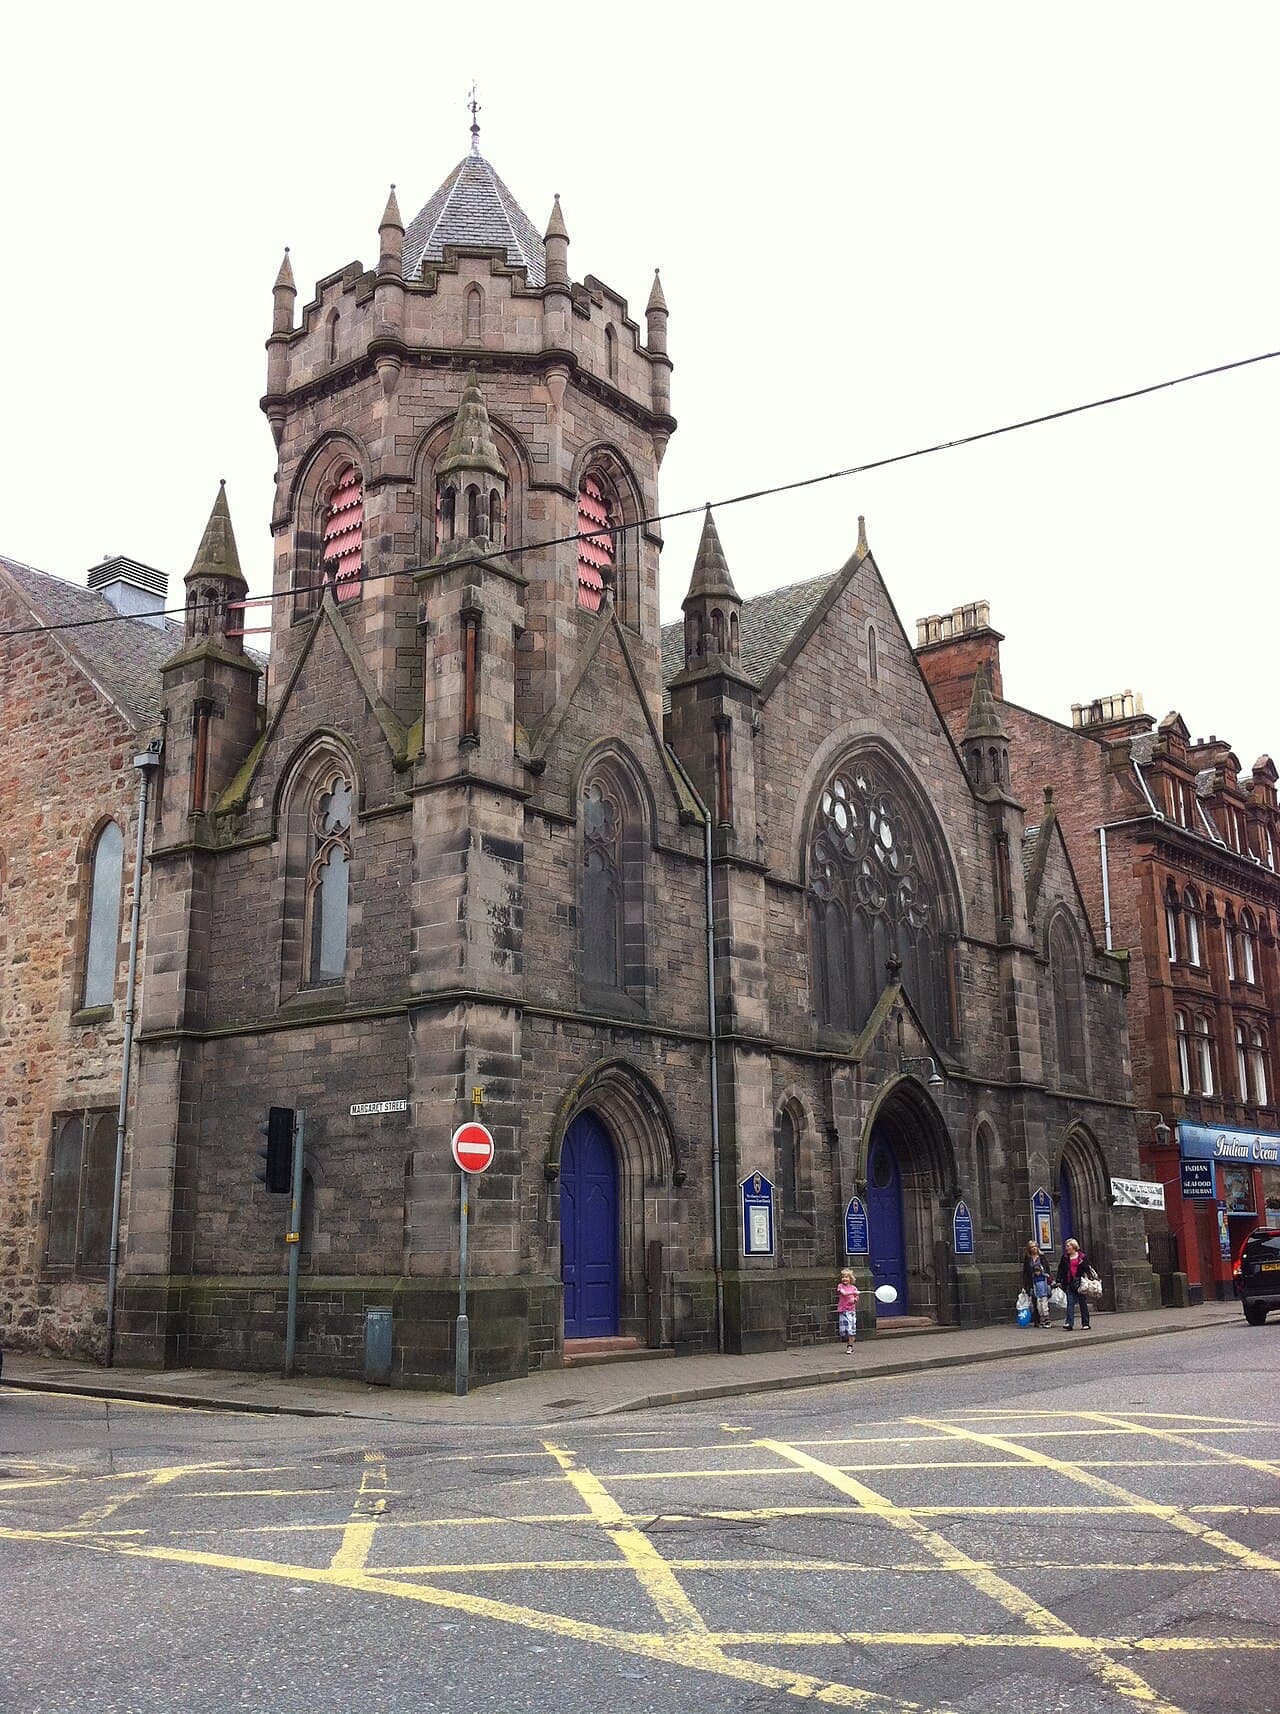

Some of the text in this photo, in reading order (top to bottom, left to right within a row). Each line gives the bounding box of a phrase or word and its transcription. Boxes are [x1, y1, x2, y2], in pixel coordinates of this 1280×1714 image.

[384, 1101, 406, 1111] STREET
[1213, 1134, 1278, 1160] Indian Ocean
